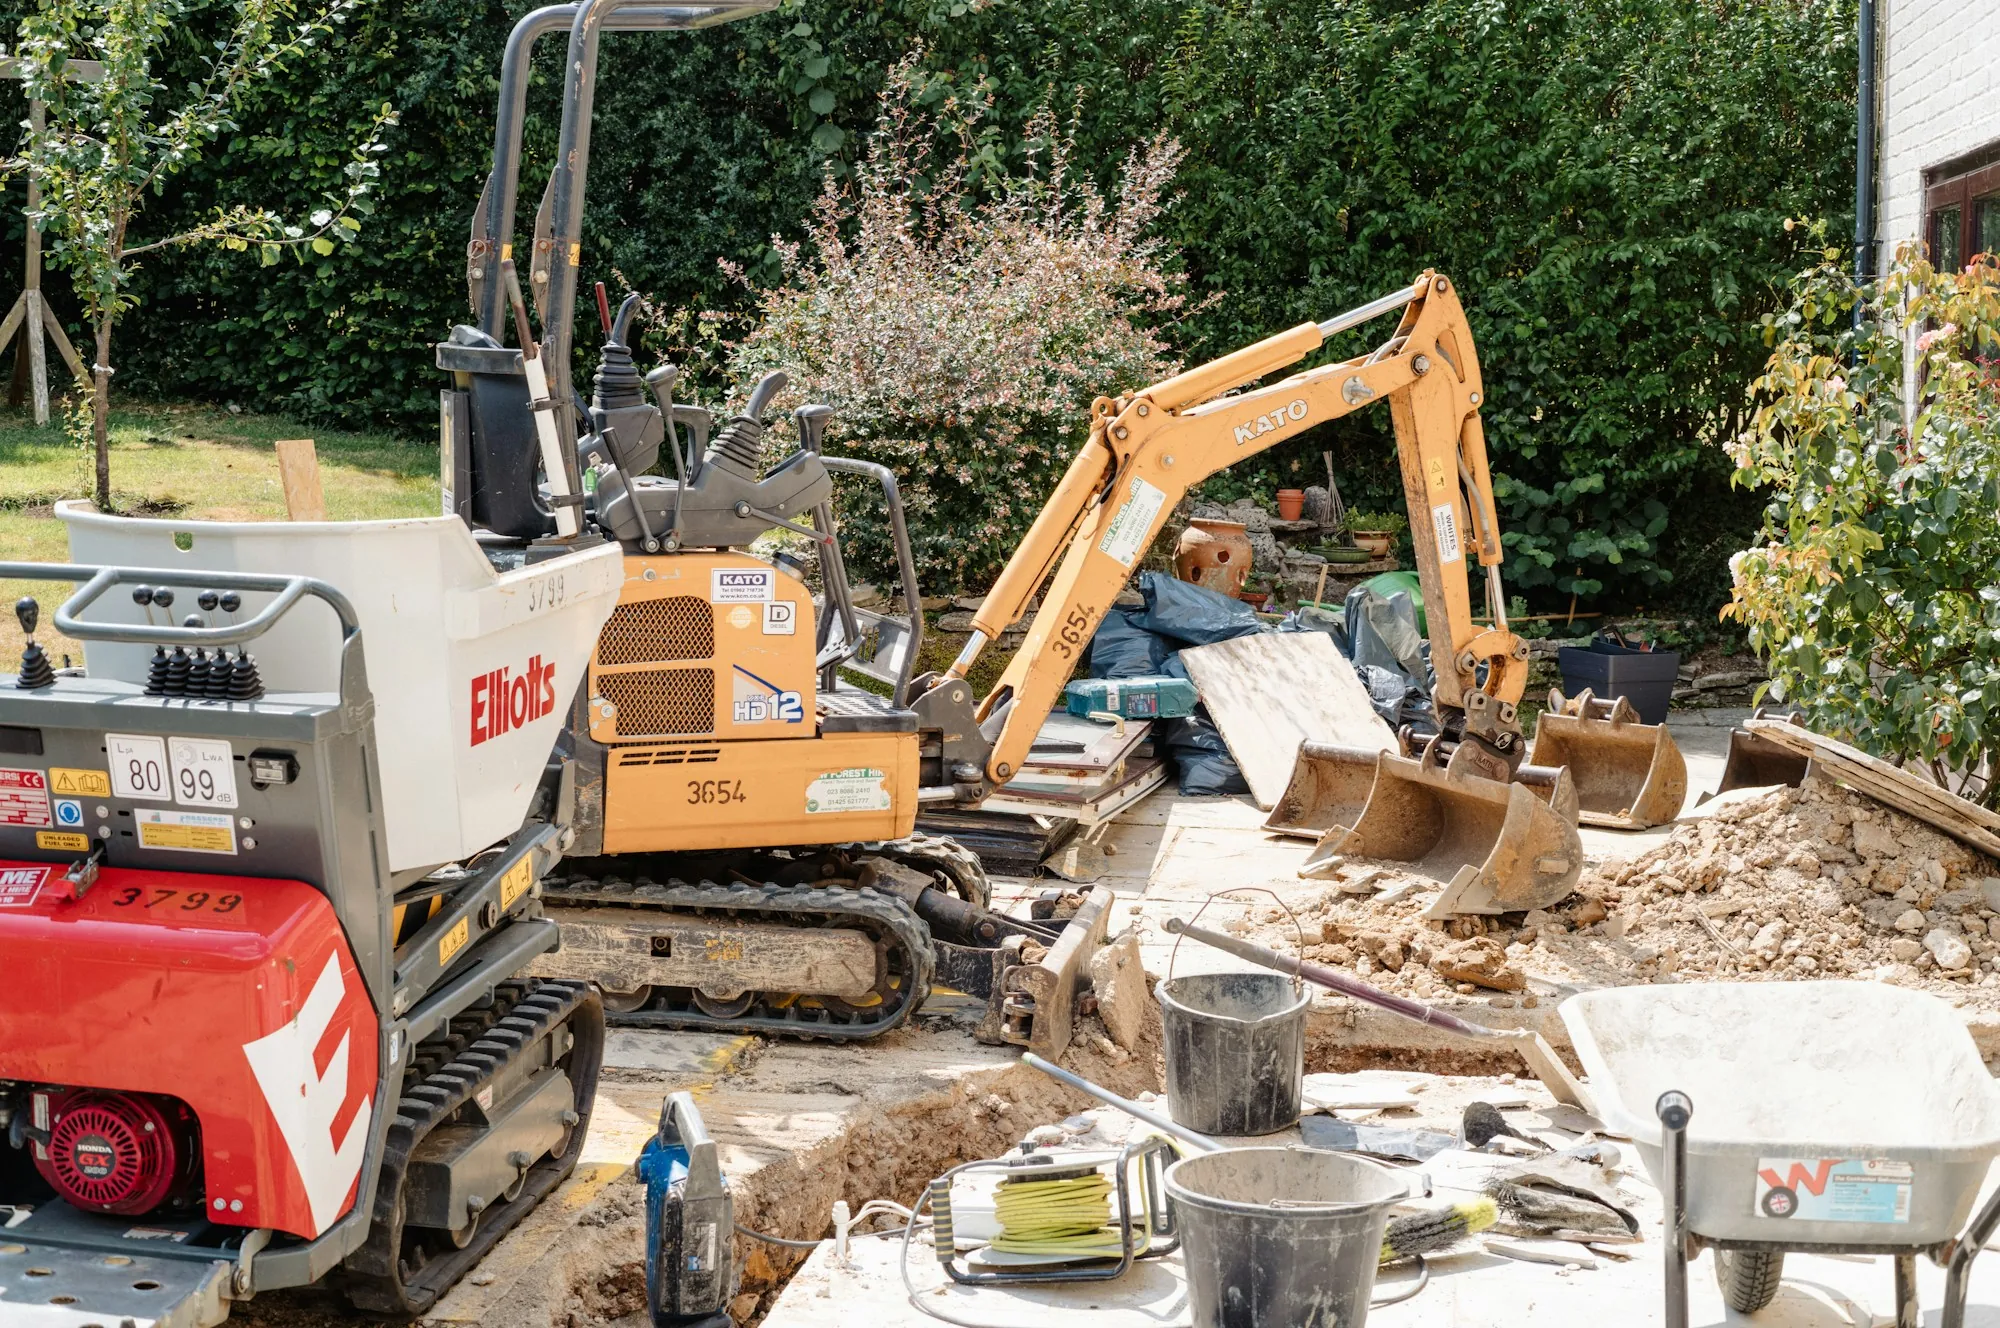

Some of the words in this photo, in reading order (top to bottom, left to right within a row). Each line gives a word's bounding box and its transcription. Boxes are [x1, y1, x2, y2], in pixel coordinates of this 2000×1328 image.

[1233, 399, 1308, 446] KATO
[1100, 525, 1116, 552] NEW
[1111, 501, 1131, 530] FORES
[1446, 514, 1457, 550] WHITES
[529, 573, 564, 613] 3799
[722, 575, 764, 585] KATO
[1052, 602, 1095, 659] 3654
[470, 654, 555, 747] Elliotts
[129, 759, 161, 792] 80
[180, 768, 214, 800] 99
[687, 779, 746, 804] 3654
[216, 793, 232, 803] dB
[112, 887, 241, 913] 3799
[77, 1144, 113, 1153] HONDA
[79, 1153, 111, 1167] GX
